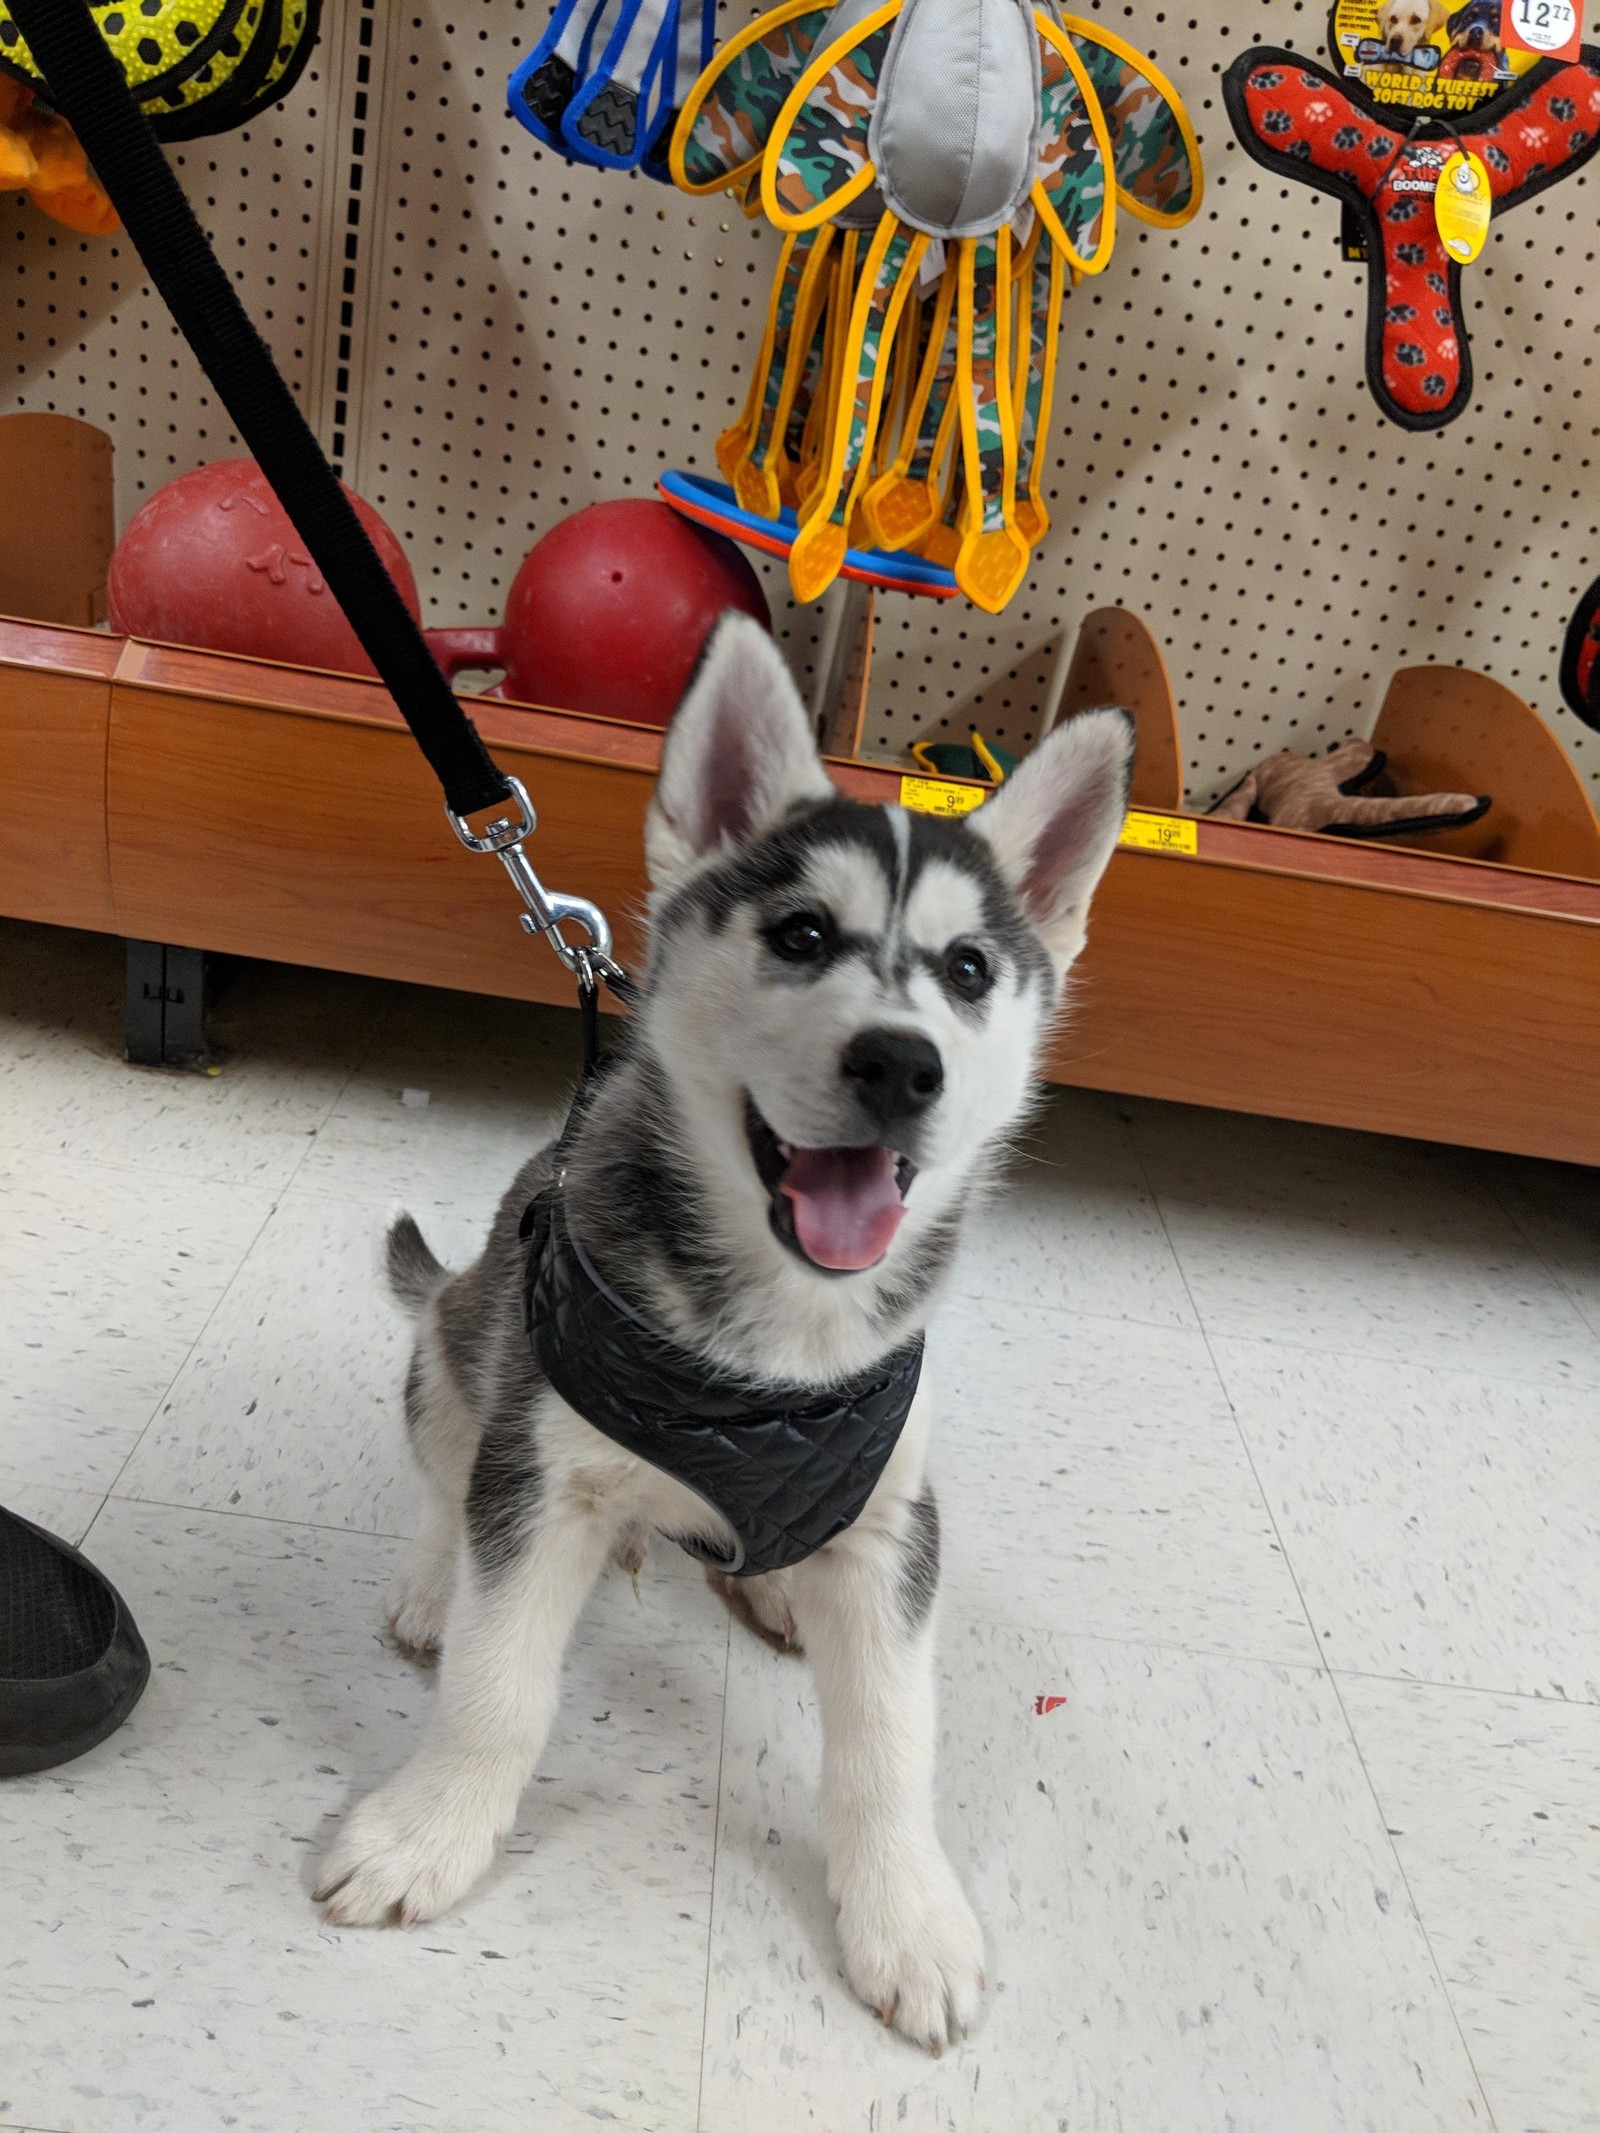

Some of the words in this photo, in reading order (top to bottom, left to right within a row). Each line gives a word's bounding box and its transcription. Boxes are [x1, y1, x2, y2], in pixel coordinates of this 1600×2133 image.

[1436, 79, 1499, 97] TUFFEST
[1373, 87, 1411, 105] SOFT
[1411, 92, 1445, 108] DOG
[1446, 95, 1477, 111] TOY
[1393, 180, 1437, 192] BOOME
